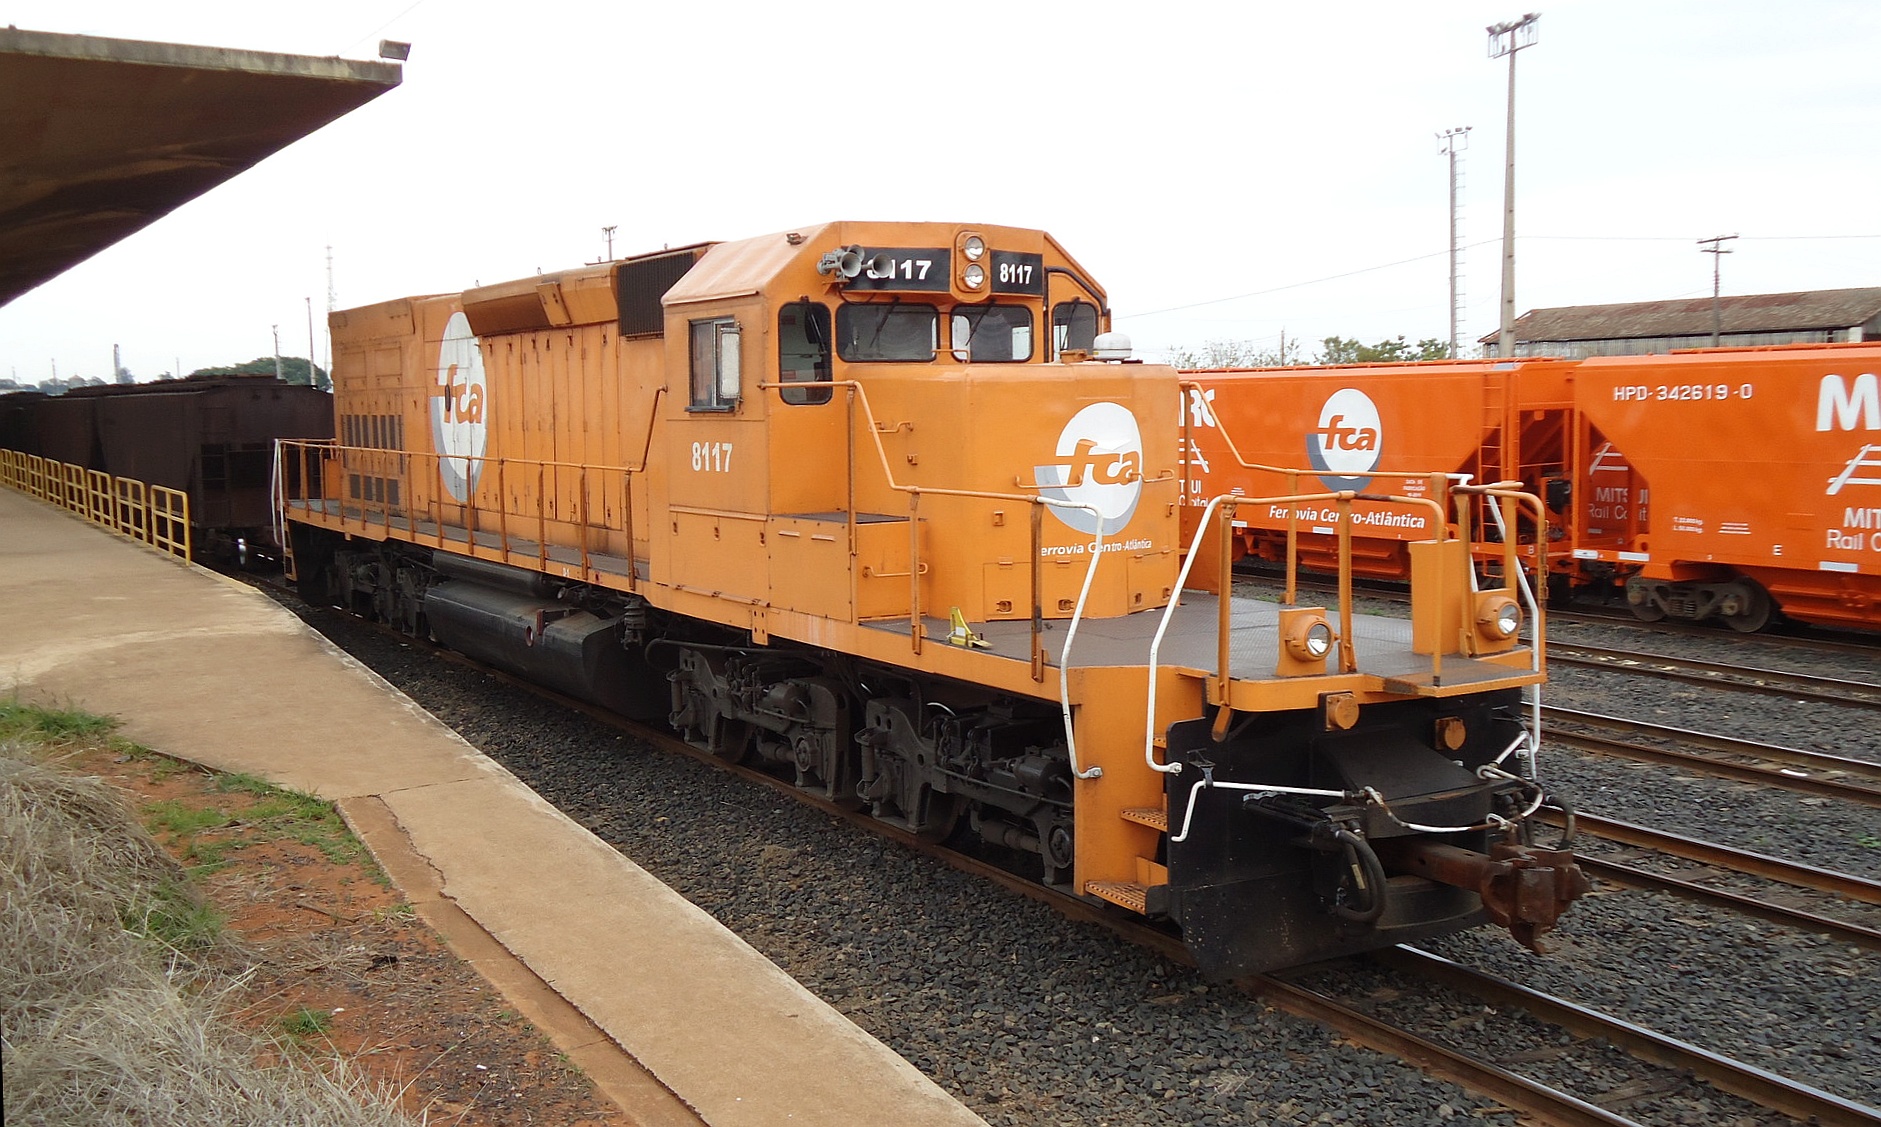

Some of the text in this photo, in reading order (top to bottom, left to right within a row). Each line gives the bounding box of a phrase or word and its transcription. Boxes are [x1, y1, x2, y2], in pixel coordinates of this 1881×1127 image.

[1000, 263, 1033, 284] 8117
[444, 363, 484, 424] fca
[1324, 414, 1377, 451] fca
[692, 441, 733, 473] 8117
[1066, 439, 1141, 486] fca
[1269, 505, 1317, 522] Fervia
[1041, 543, 1084, 556] errovia
[1826, 529, 1864, 551] Rail
